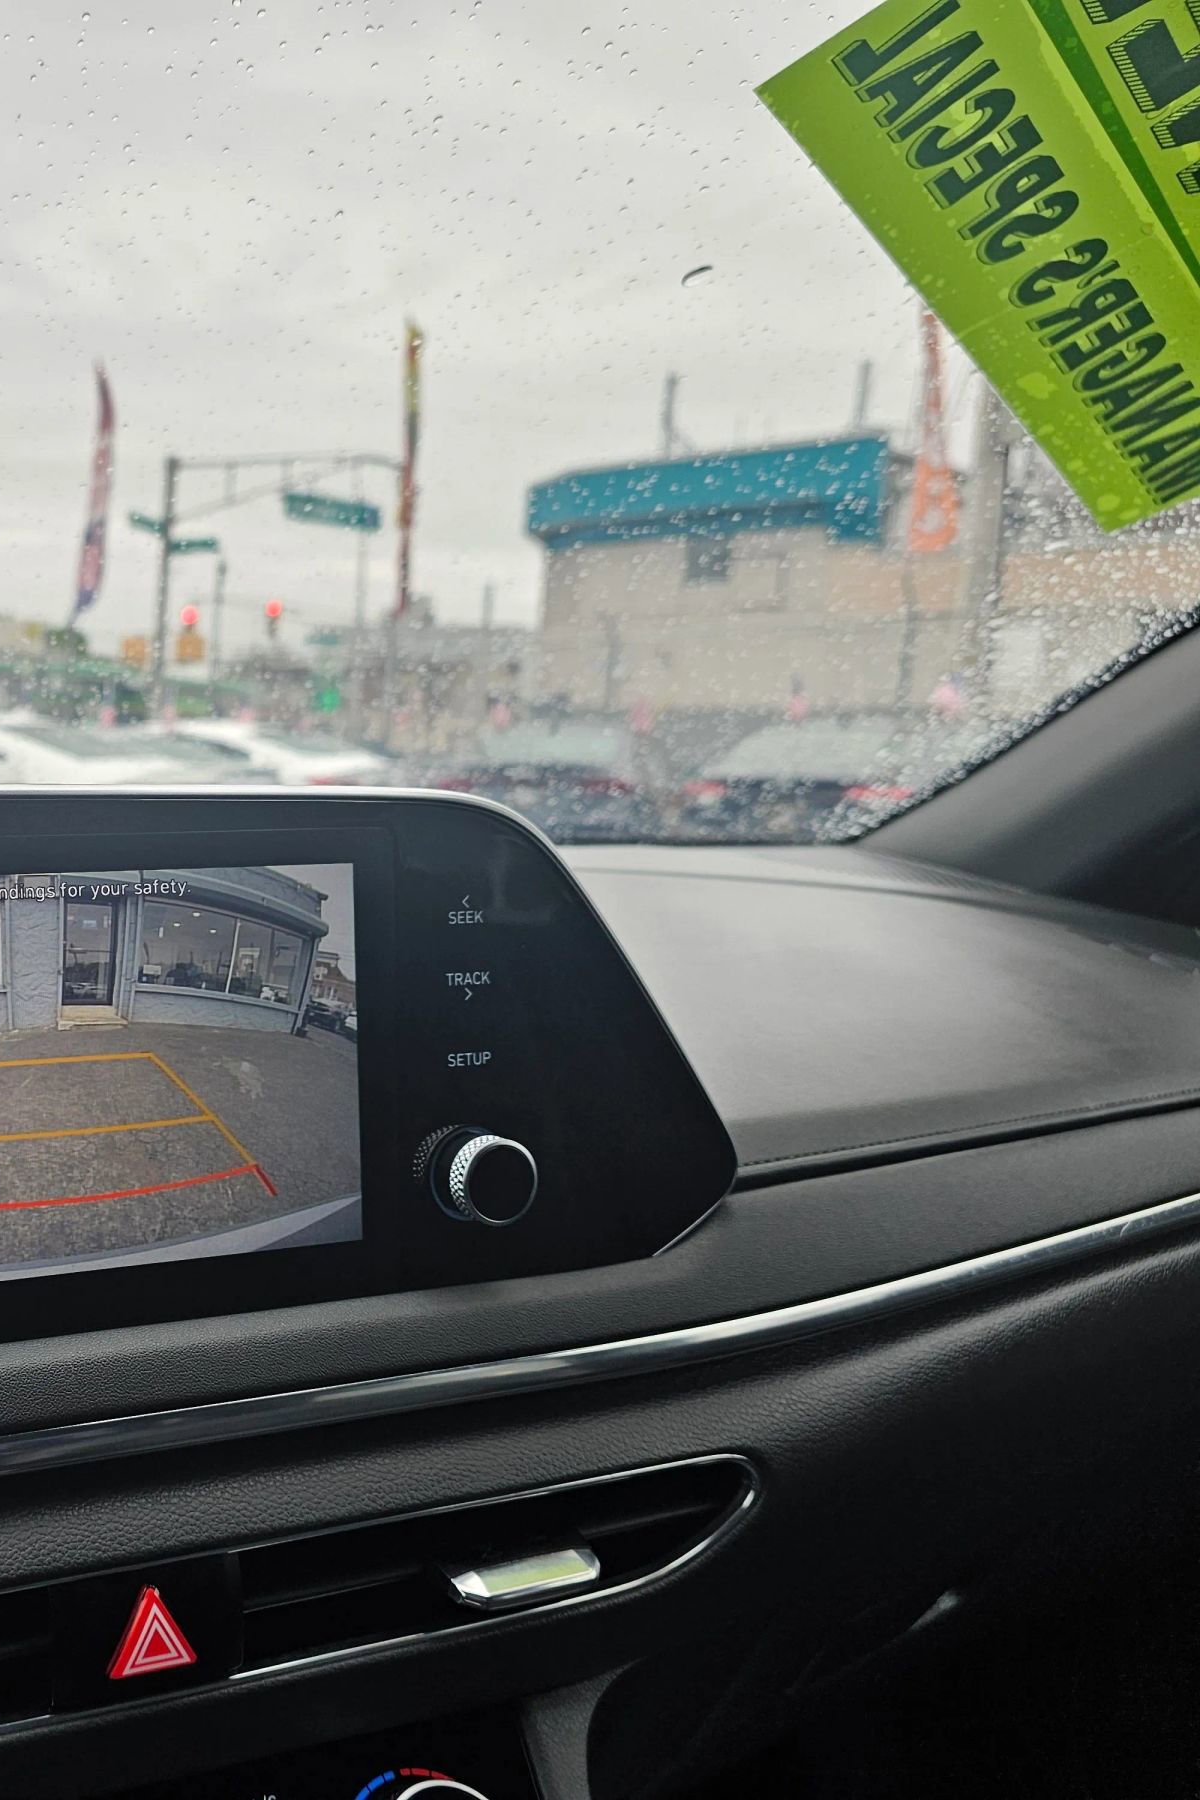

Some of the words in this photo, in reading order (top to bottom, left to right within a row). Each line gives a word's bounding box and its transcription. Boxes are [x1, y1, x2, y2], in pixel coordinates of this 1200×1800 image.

[60, 882, 85, 897] for
[90, 883, 128, 900] your
[134, 879, 191, 896] safety.
[448, 911, 483, 924] SEEK
[446, 971, 490, 986] TRACK
[448, 1052, 491, 1067] SETUP
